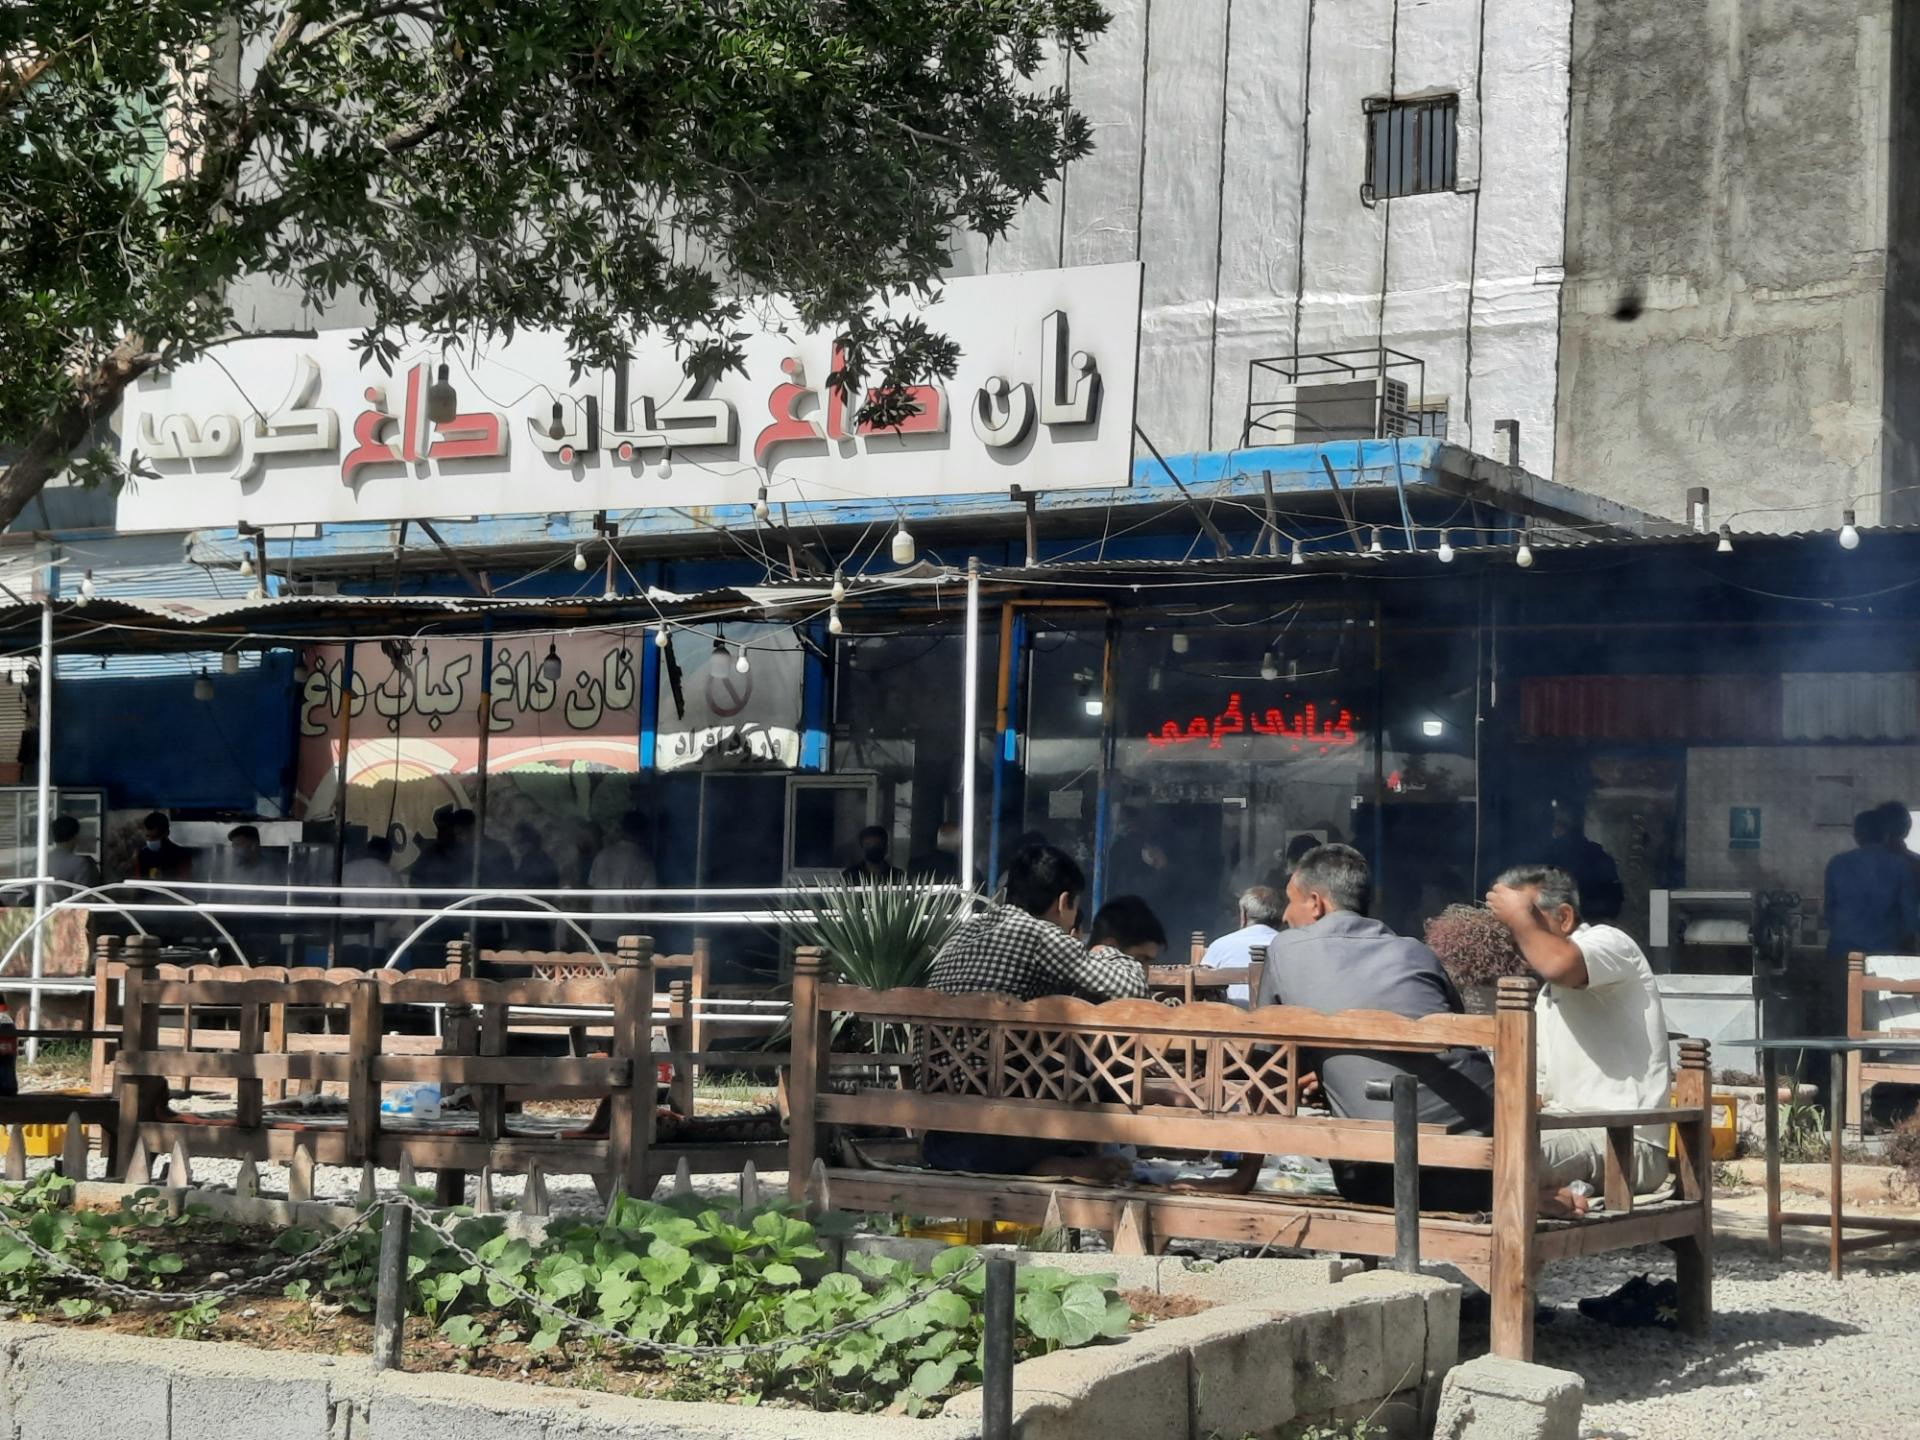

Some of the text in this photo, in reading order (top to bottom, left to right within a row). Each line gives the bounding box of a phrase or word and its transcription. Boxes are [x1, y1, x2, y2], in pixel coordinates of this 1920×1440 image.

[137, 309, 1102, 490] نان داغ کباب داغ کرمی
[300, 648, 636, 737] نان داغ کباب داغ
